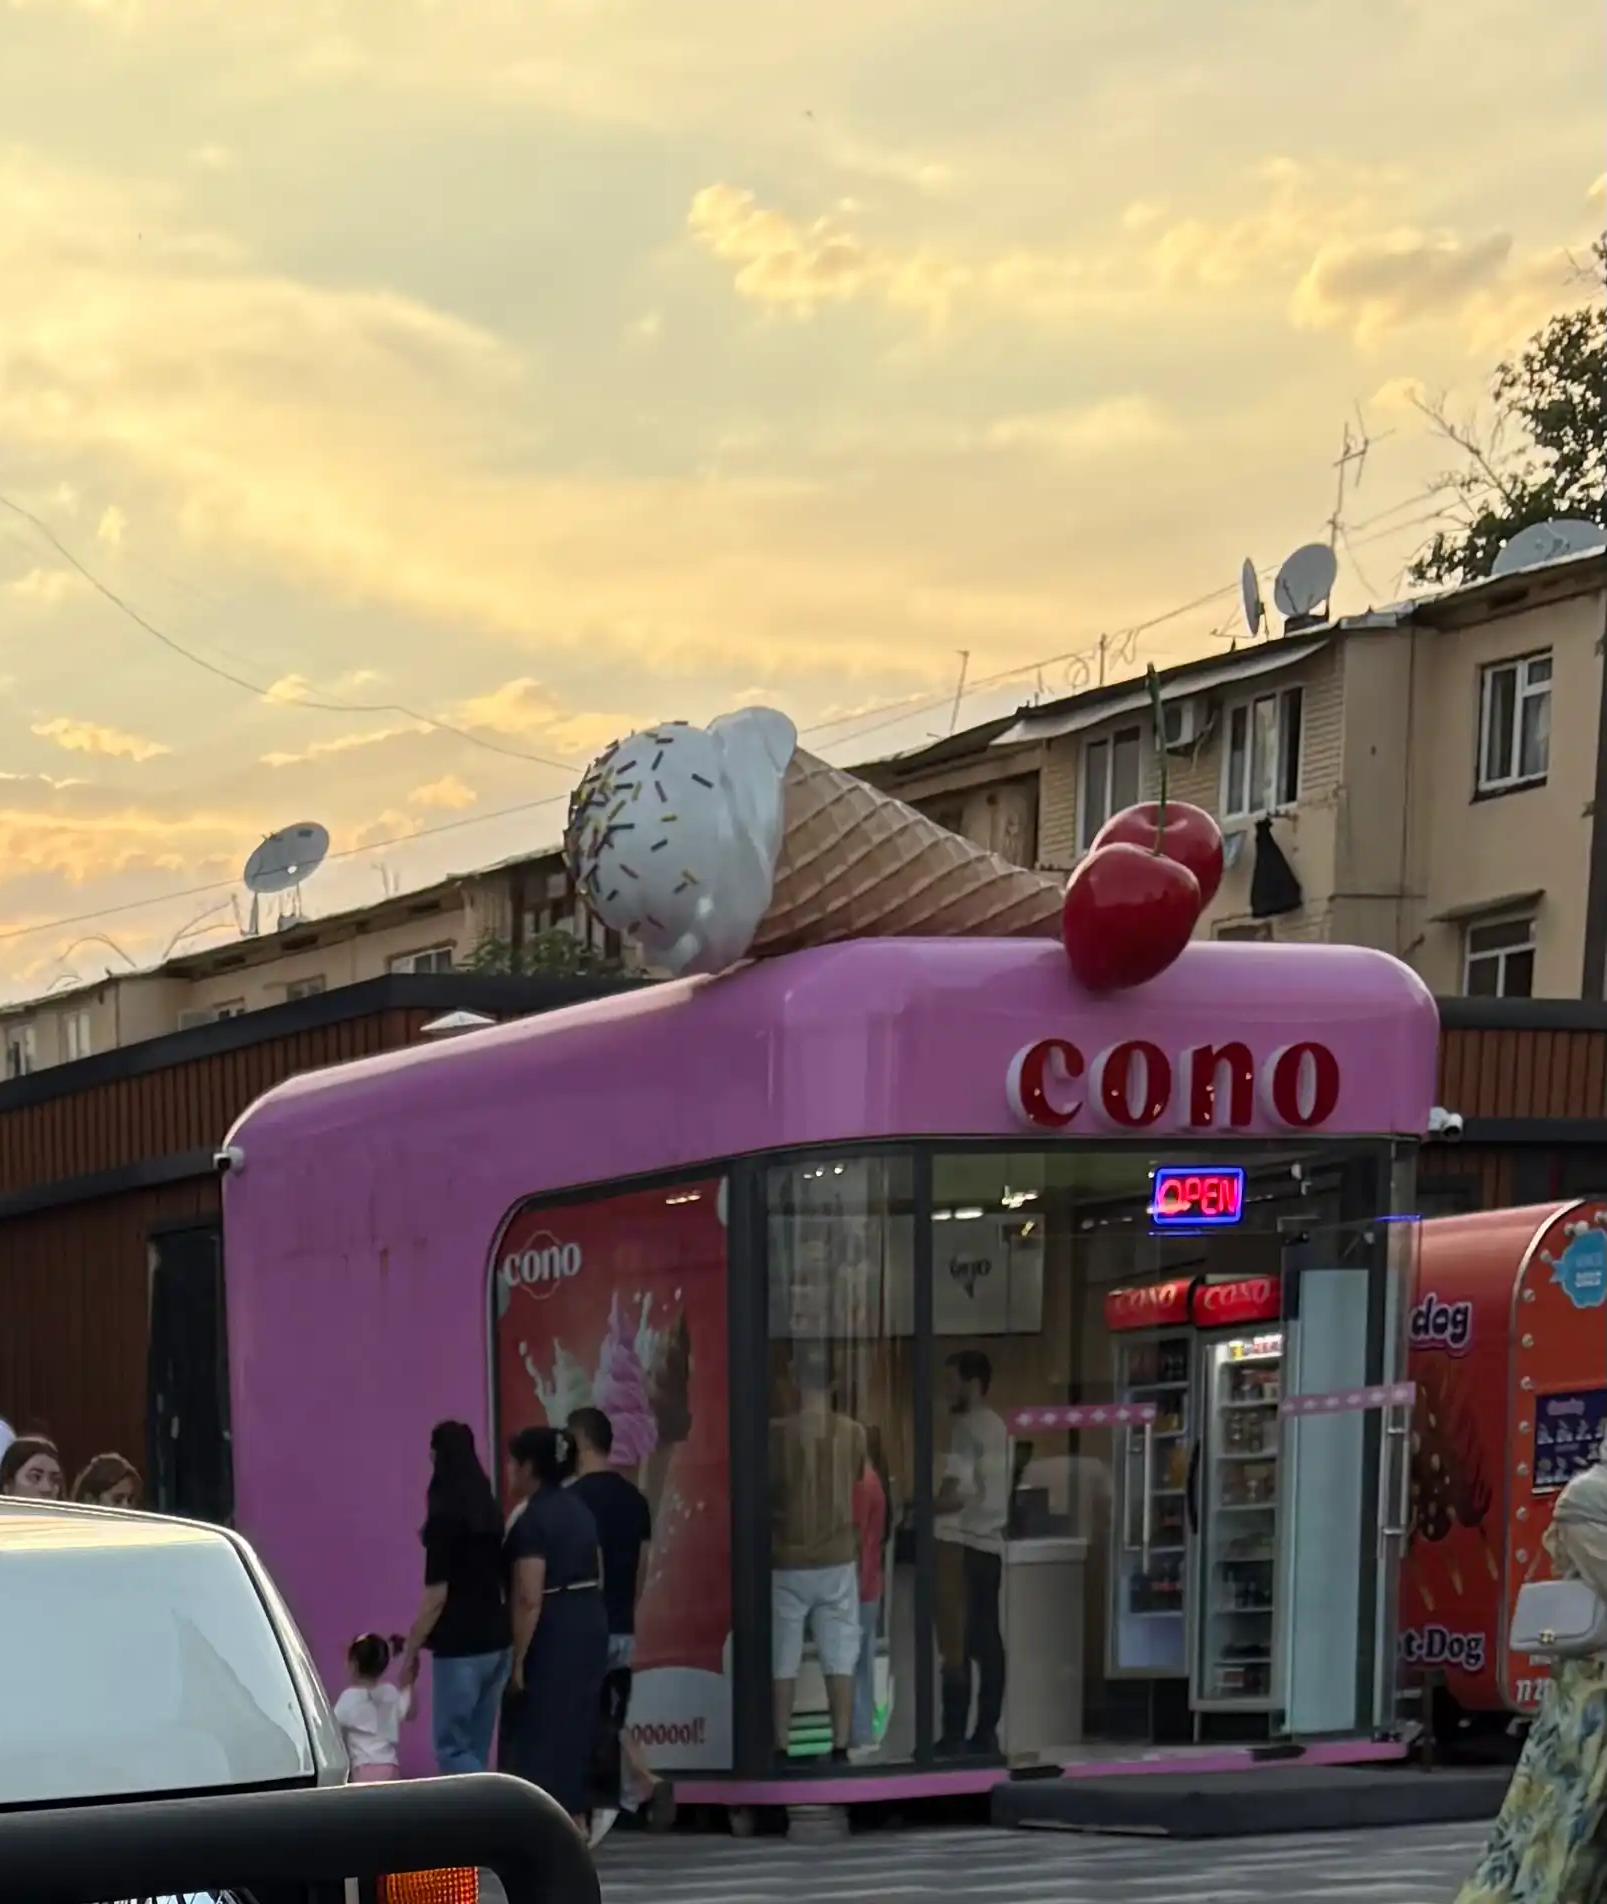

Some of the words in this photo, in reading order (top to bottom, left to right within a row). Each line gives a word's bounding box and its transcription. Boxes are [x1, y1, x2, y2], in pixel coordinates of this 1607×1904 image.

[1006, 1038, 1340, 1128] cono
[1157, 1176, 1239, 1215] OPEN
[504, 1243, 581, 1287] cono
[1409, 1293, 1471, 1347] dog
[1397, 1625, 1485, 1668] t-Dog
